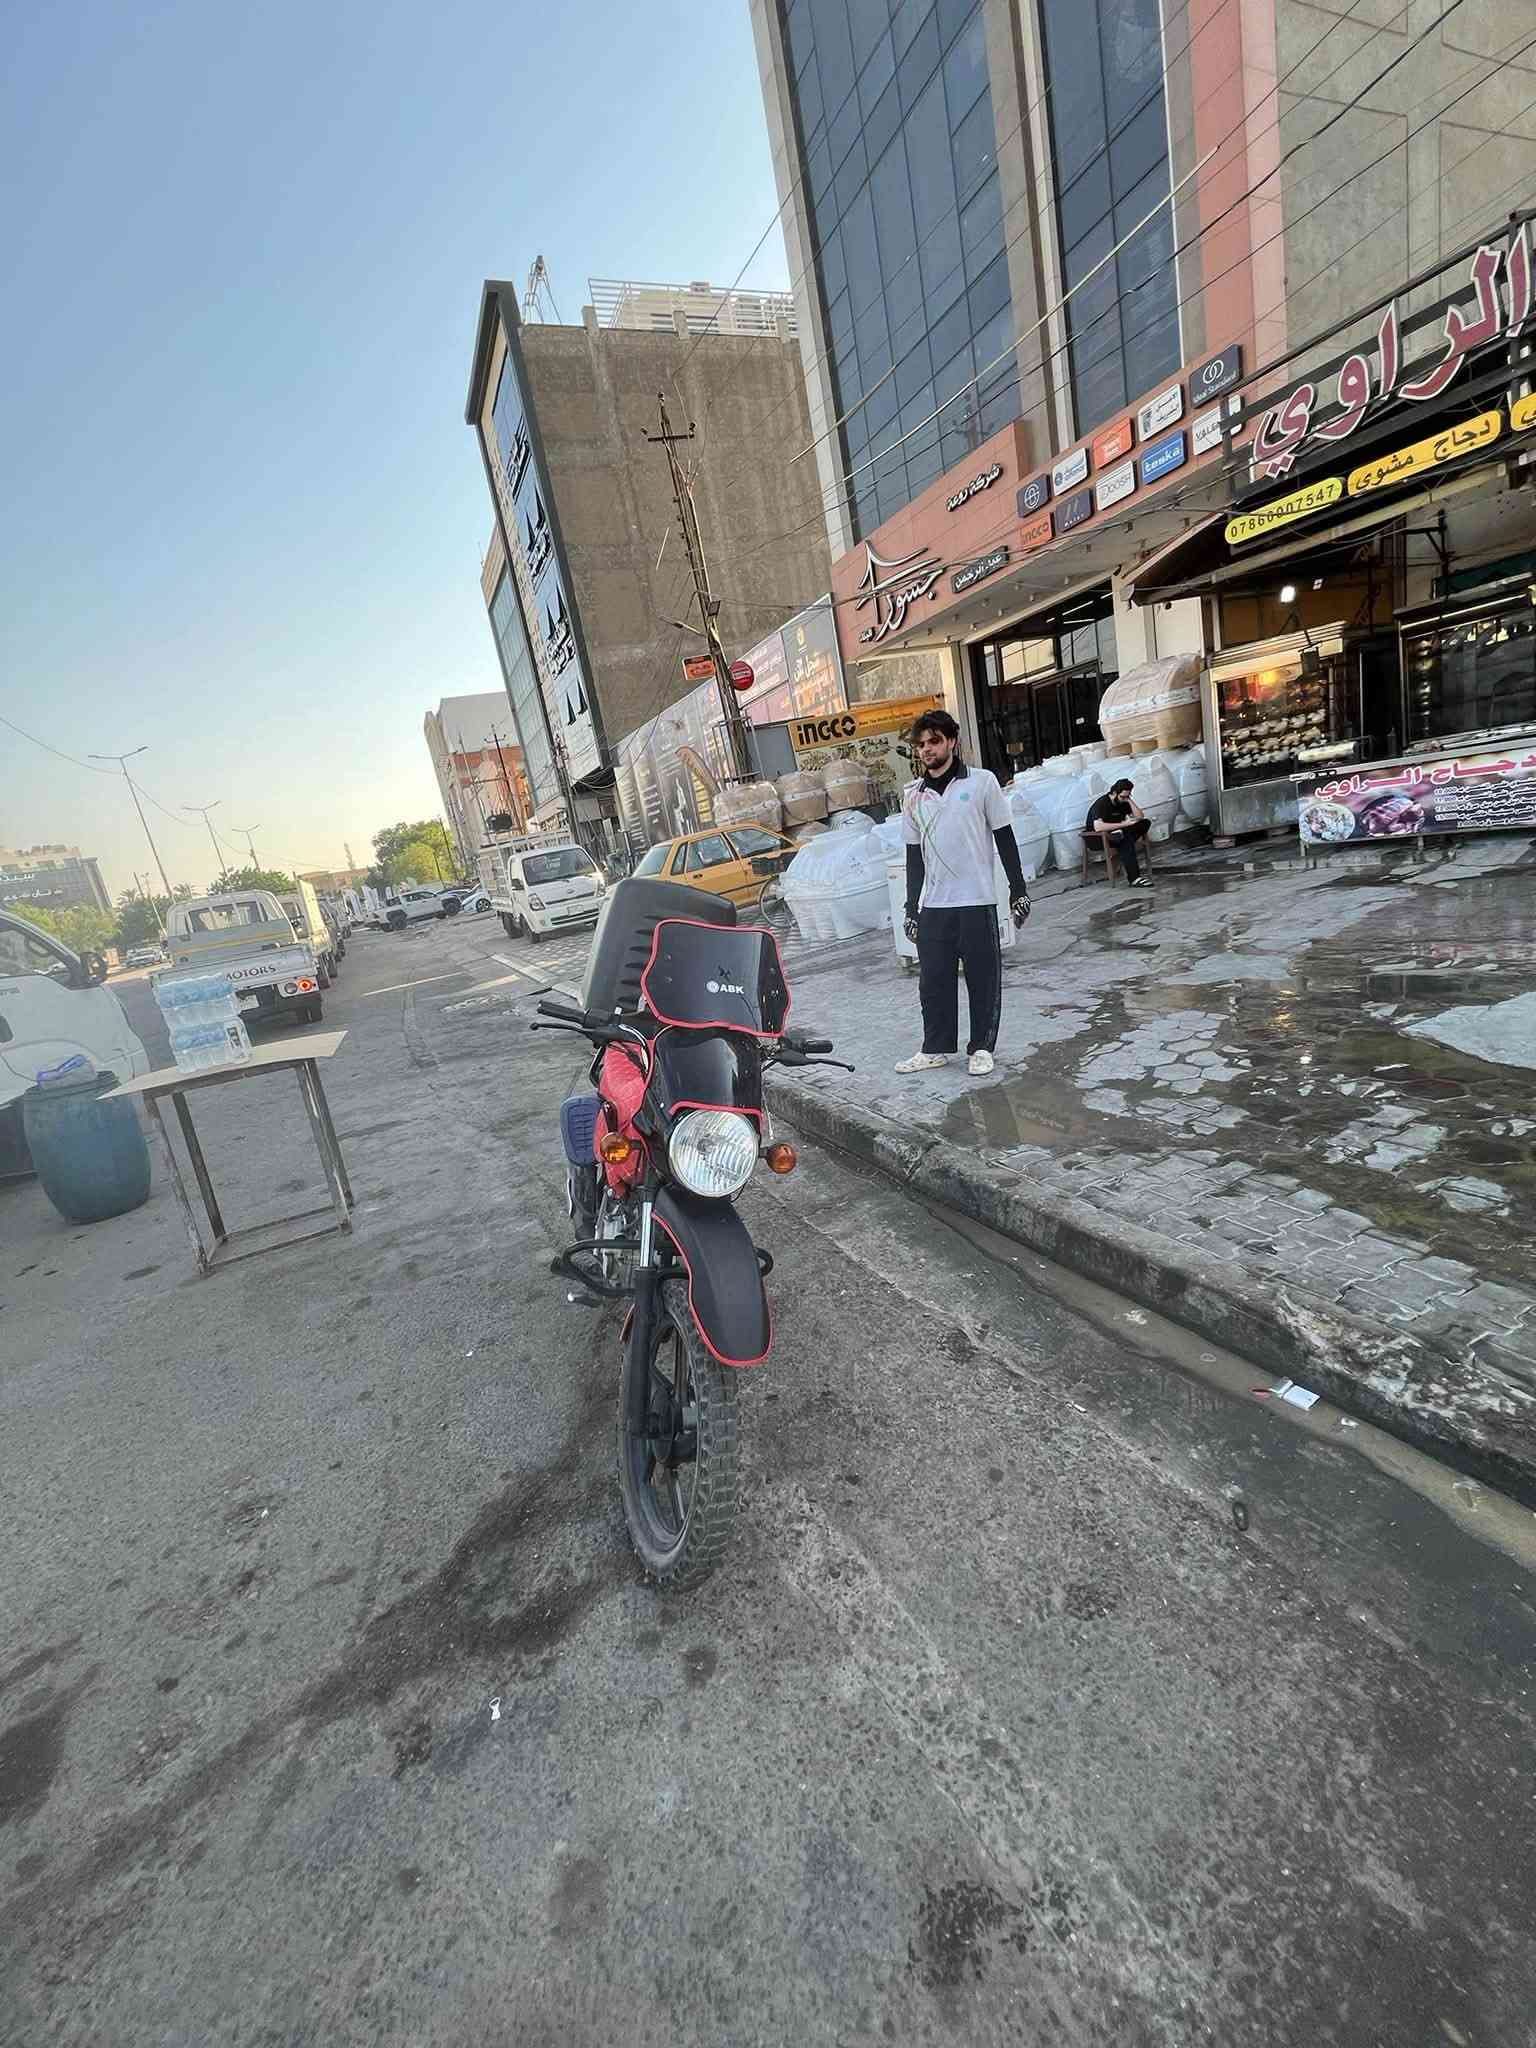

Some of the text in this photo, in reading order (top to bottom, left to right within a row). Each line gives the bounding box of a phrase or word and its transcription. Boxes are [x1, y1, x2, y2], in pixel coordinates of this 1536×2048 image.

[1254, 222, 1531, 479] الراوي
[1433, 419, 1490, 462] دجاج
[969, 463, 1001, 493] شركة
[955, 560, 985, 589] الرحمن
[1314, 765, 1423, 802] الراوي
[720, 984, 745, 994] ABK
